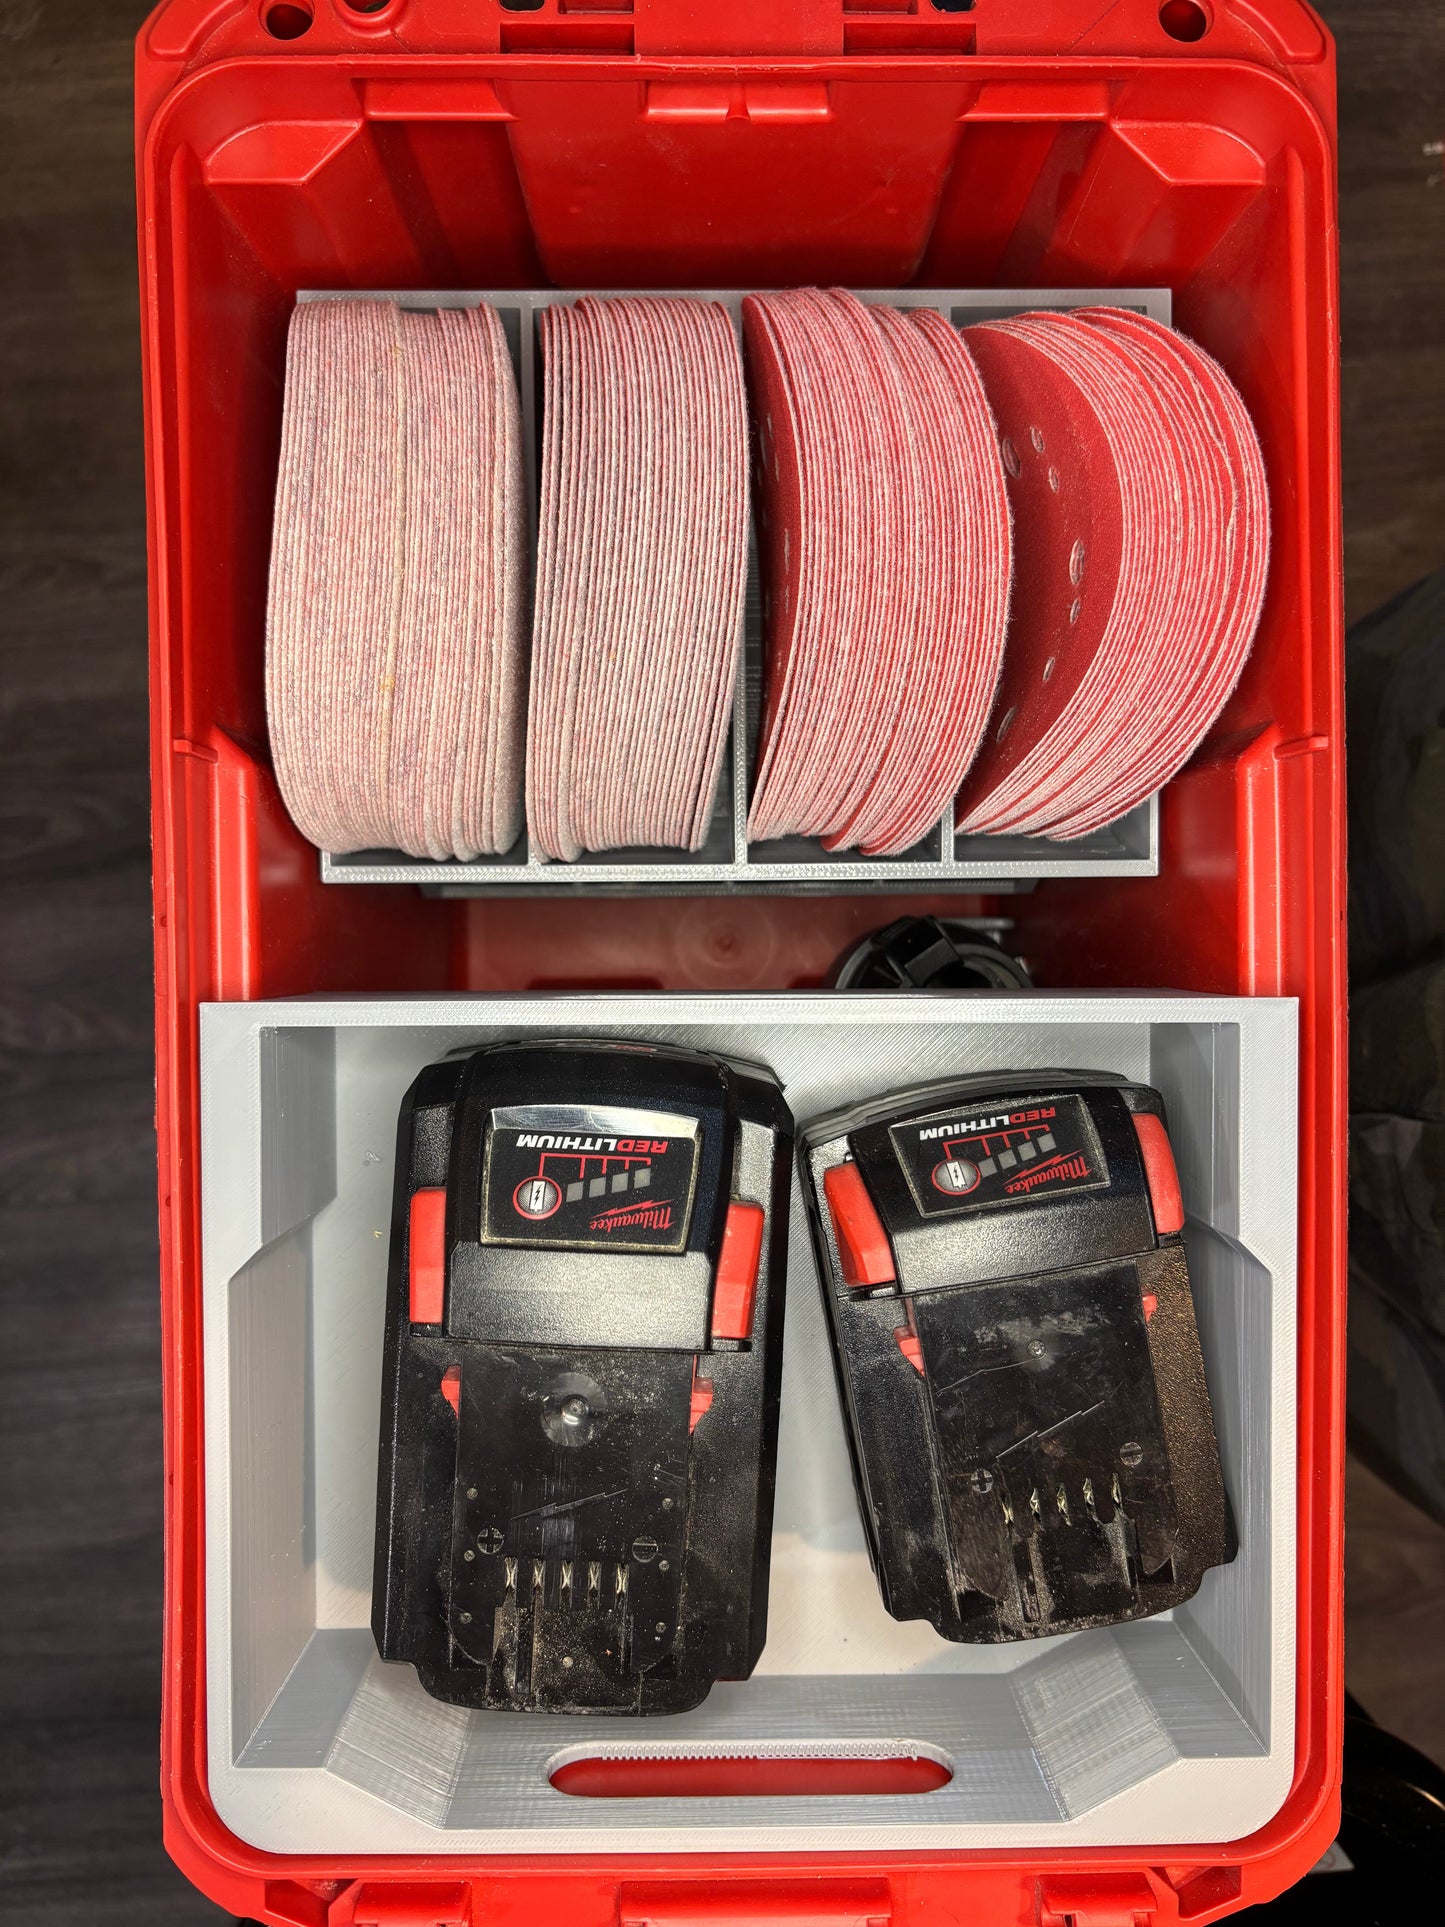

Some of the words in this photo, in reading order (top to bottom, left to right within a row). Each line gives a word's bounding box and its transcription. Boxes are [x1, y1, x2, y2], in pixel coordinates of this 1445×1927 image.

[919, 1106, 1056, 1141] REDLITHIUM
[516, 1134, 669, 1154] REDLITHIUM
[1004, 1156, 1092, 1194] Milwaukee
[588, 1207, 676, 1233] Milwaukee
